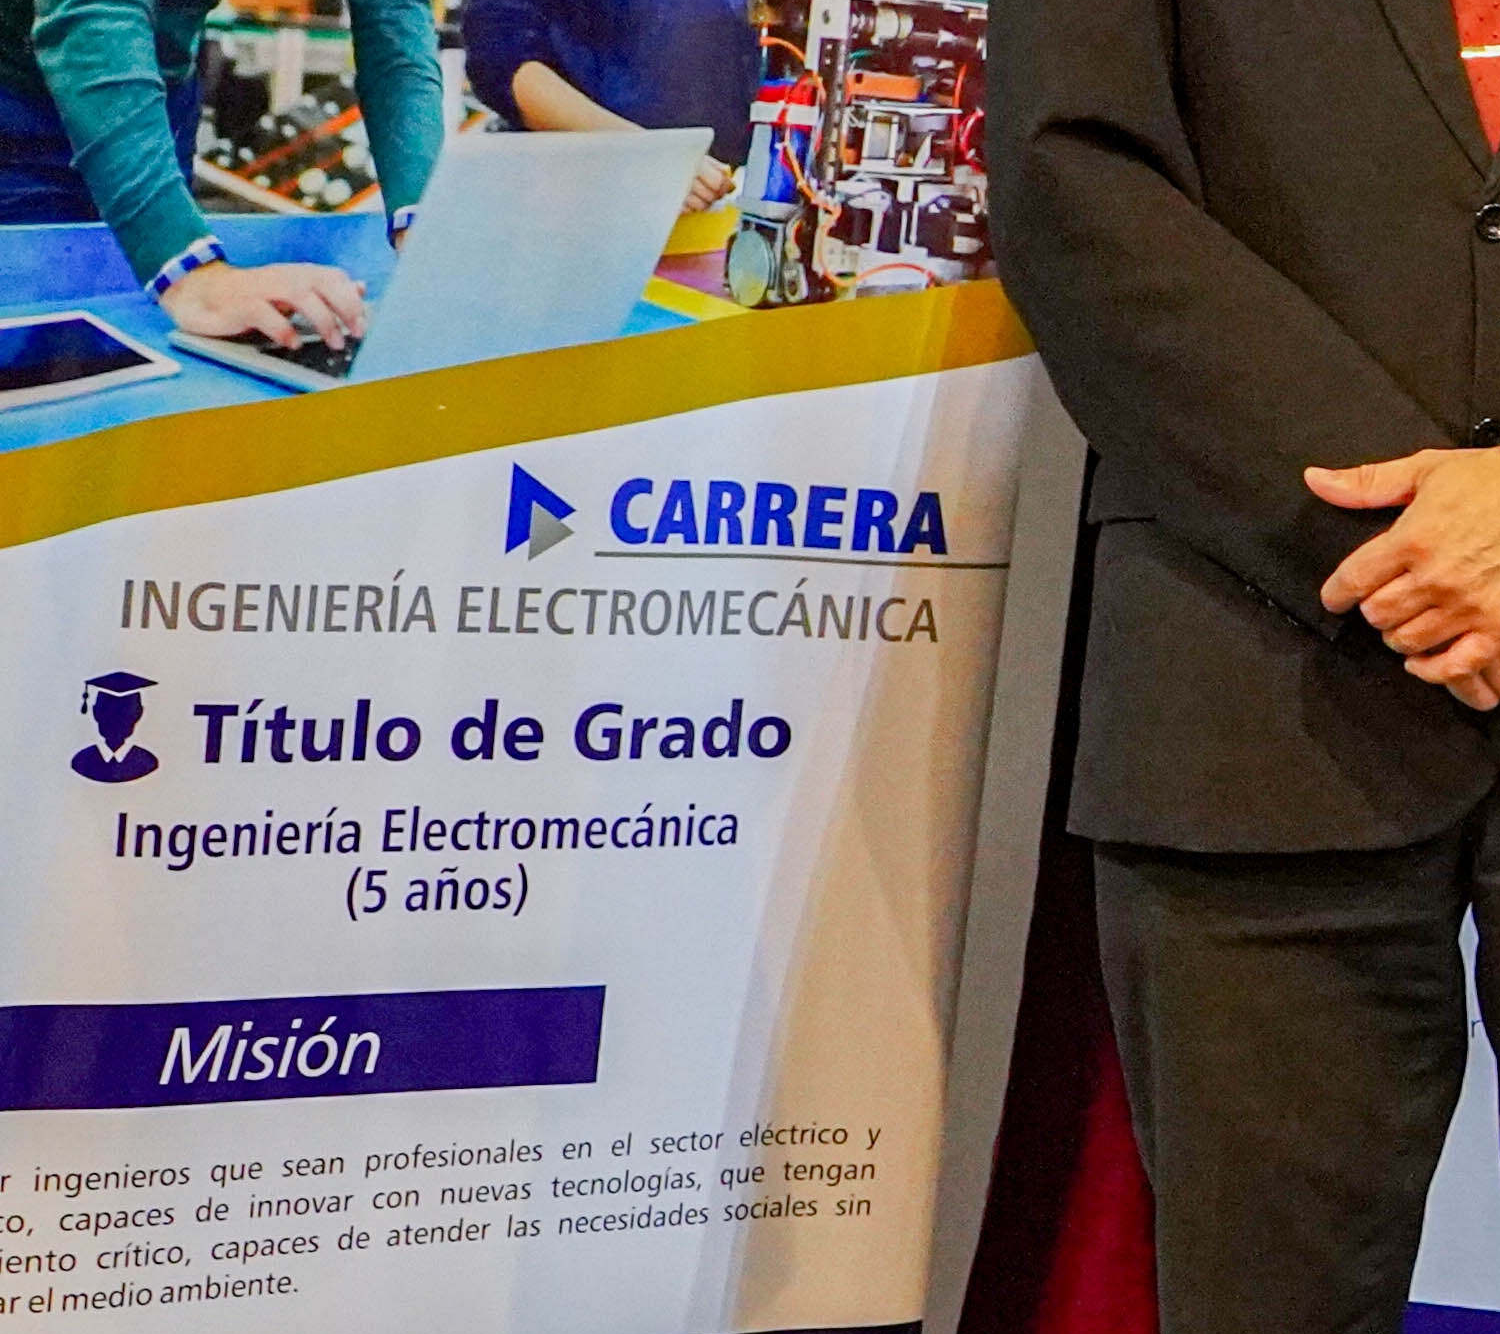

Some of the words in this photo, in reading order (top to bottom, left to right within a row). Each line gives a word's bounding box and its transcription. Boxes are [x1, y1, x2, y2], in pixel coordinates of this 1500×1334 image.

[608, 479, 948, 555] CARRERA
[120, 571, 437, 635] INGENIERÍA
[455, 579, 939, 643] ELECTROMECÁNICA
[193, 698, 421, 764] Título
[451, 703, 545, 762] de
[573, 698, 793, 760] Grado
[115, 807, 361, 871] Ingeniería
[382, 803, 740, 855] Electromecánica
[345, 872, 389, 923] (5
[404, 862, 529, 915] años)
[158, 1017, 381, 1086] Misión
[34, 1164, 191, 1199] ingenieros
[210, 1161, 264, 1187] que
[282, 1156, 345, 1177] sean
[365, 1139, 543, 1178] profesionales
[562, 1142, 592, 1162] en
[611, 1133, 633, 1157] el
[650, 1131, 724, 1156] sector
[739, 1122, 848, 1148] eléctrico
[868, 1125, 882, 1150] y
[59, 1206, 175, 1236] capaces
[196, 1197, 229, 1223] de
[250, 1192, 354, 1219] innovar
[372, 1187, 420, 1210] con
[440, 1182, 531, 1206] nuevas
[551, 1165, 702, 1198] tecnologías,
[720, 1163, 765, 1189] que
[783, 1159, 876, 1187] tengan
[96, 1243, 192, 1271] crítico,
[210, 1235, 320, 1264] capaces
[338, 1225, 371, 1252] de
[386, 1219, 490, 1248] atender
[506, 1213, 541, 1239] las
[558, 1202, 709, 1236] necesidades
[723, 1195, 818, 1222] sociales
[835, 1196, 872, 1217] sin
[29, 1287, 53, 1313] el
[62, 1282, 153, 1312] medio
[160, 1273, 299, 1304] ambiente.
